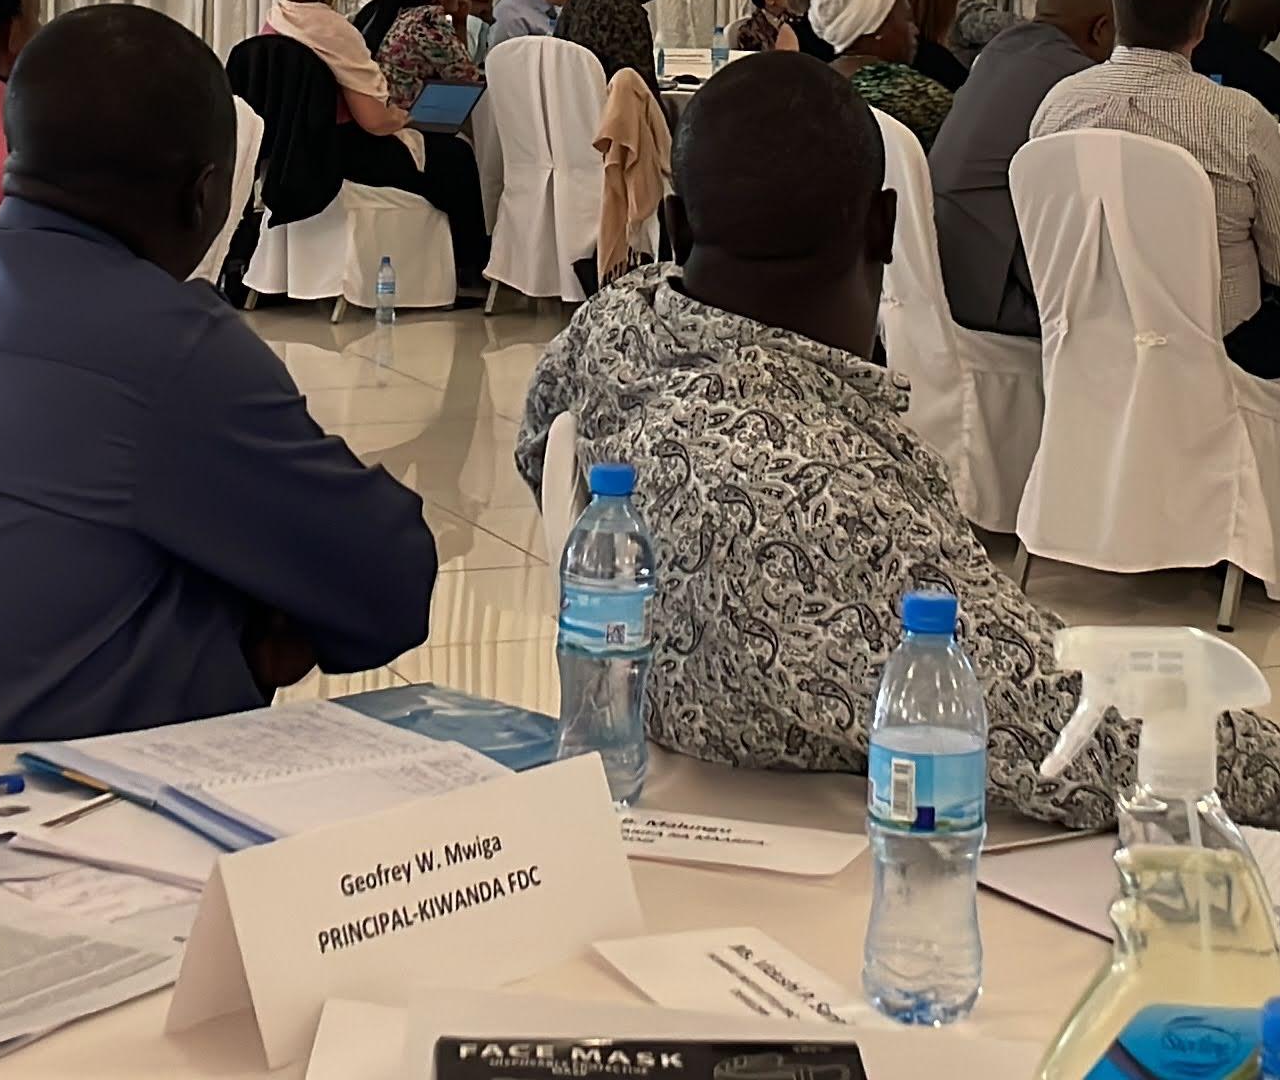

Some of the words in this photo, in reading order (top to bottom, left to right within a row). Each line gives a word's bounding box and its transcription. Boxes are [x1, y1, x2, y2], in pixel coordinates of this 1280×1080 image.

[340, 859, 412, 897] Geofrey
[415, 849, 442, 874] W.
[444, 834, 502, 867] Mwiga
[318, 877, 506, 954] PRINCIPAL-KIWANDA
[507, 865, 542, 894] FDC
[459, 1042, 555, 1060] FACE
[571, 1046, 684, 1069] MASK
